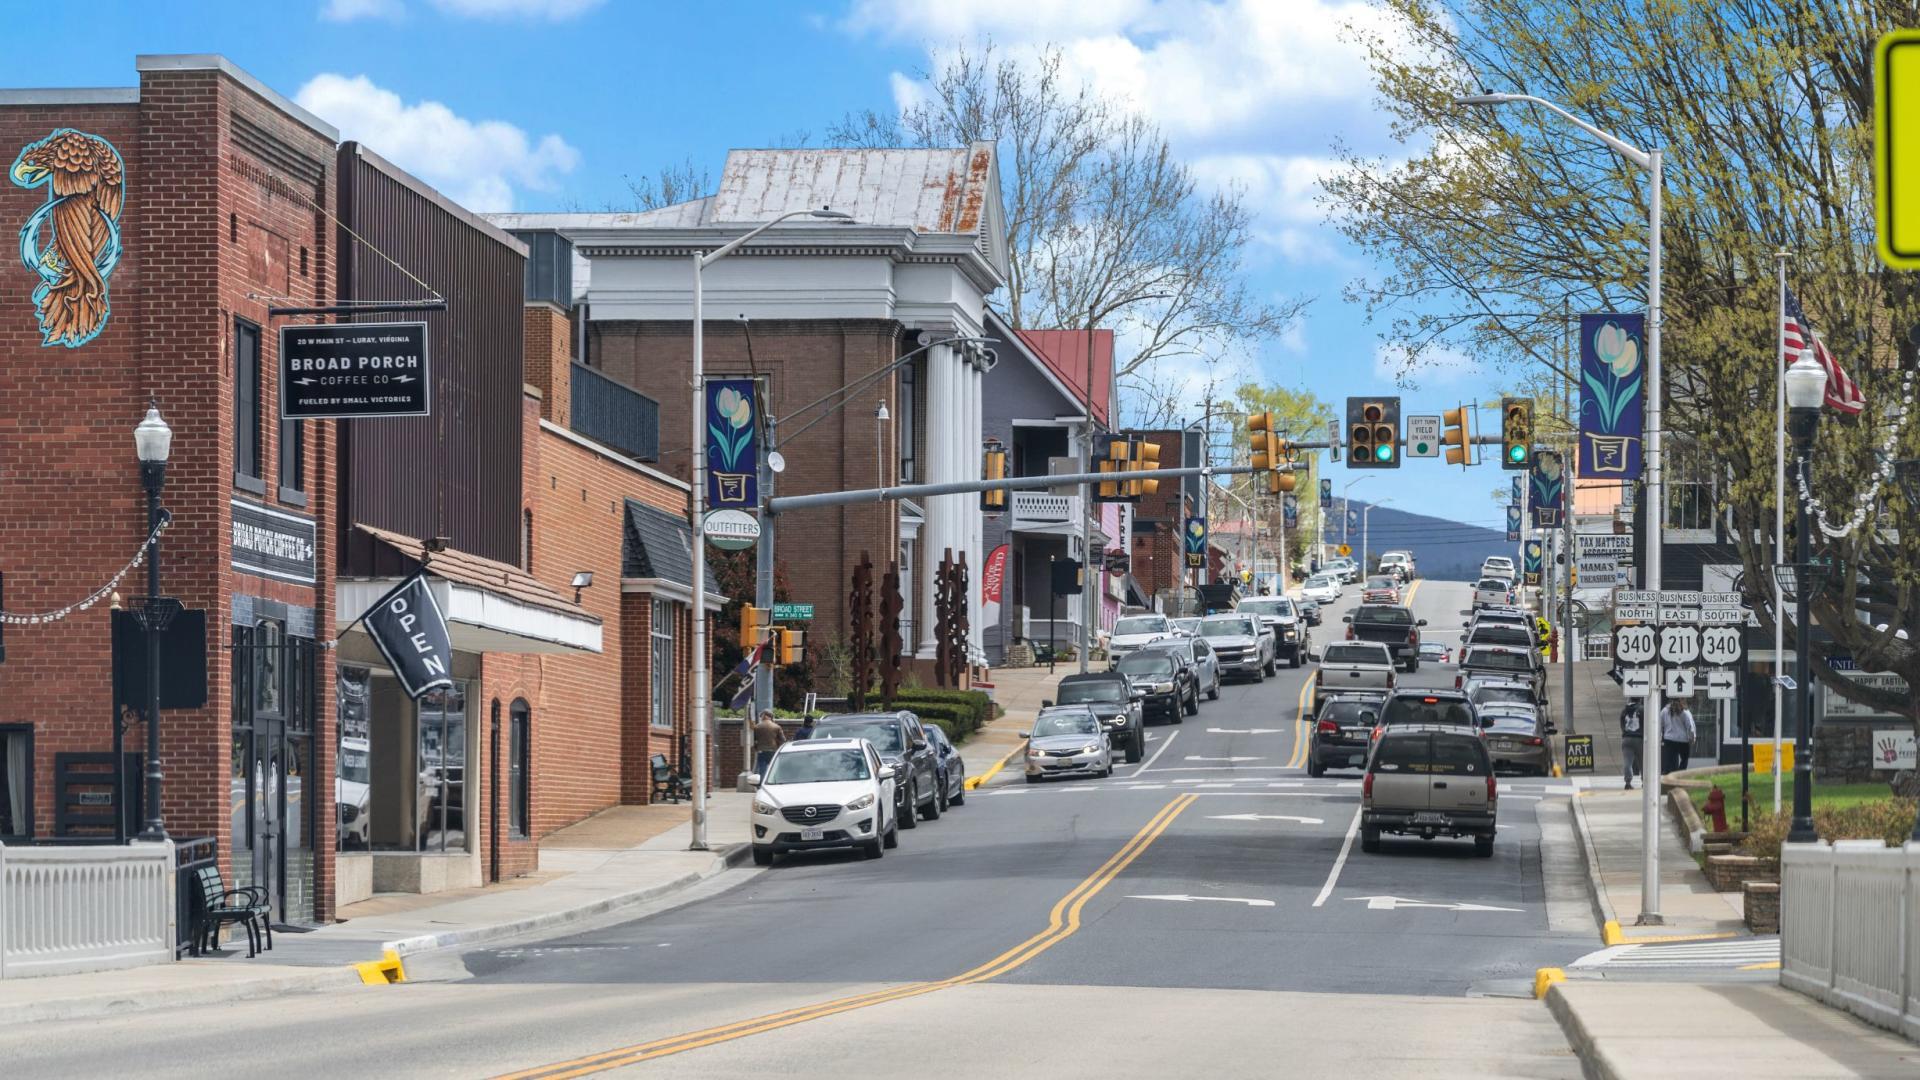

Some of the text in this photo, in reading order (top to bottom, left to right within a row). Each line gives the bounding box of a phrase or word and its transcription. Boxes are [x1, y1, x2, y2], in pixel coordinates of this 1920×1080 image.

[352, 336, 377, 344] LURAY,
[291, 355, 418, 371] BROAD PORCH
[320, 374, 389, 386] COFFEE CO
[370, 395, 412, 403] VICTORIES
[1415, 426, 1433, 434] YIELD
[705, 521, 759, 534] OUTFITTERS
[233, 521, 254, 550] BROAD
[254, 526, 274, 555] PORCH
[274, 531, 297, 560] COFFEE
[1580, 536, 1631, 548] TAX MATTERS
[1580, 562, 1615, 572] MAMA'S
[1580, 574, 1616, 584] TREASURES
[1618, 591, 1656, 601] BUSINESS
[1660, 592, 1698, 602] BUSINESS
[1702, 594, 1740, 603] BUSINESS
[774, 605, 813, 613] BROAD STREET
[1620, 610, 1654, 618] NORTH
[1665, 611, 1692, 620] EAST
[1704, 612, 1738, 620] SOUTH
[390, 597, 446, 676] OPEN
[1621, 634, 1651, 654] 340
[1668, 635, 1691, 654] 211
[1707, 635, 1736, 655] 340
[1854, 677, 1877, 685] HAPPY
[1568, 744, 1589, 756] ART
[1567, 756, 1592, 766] OPEN
